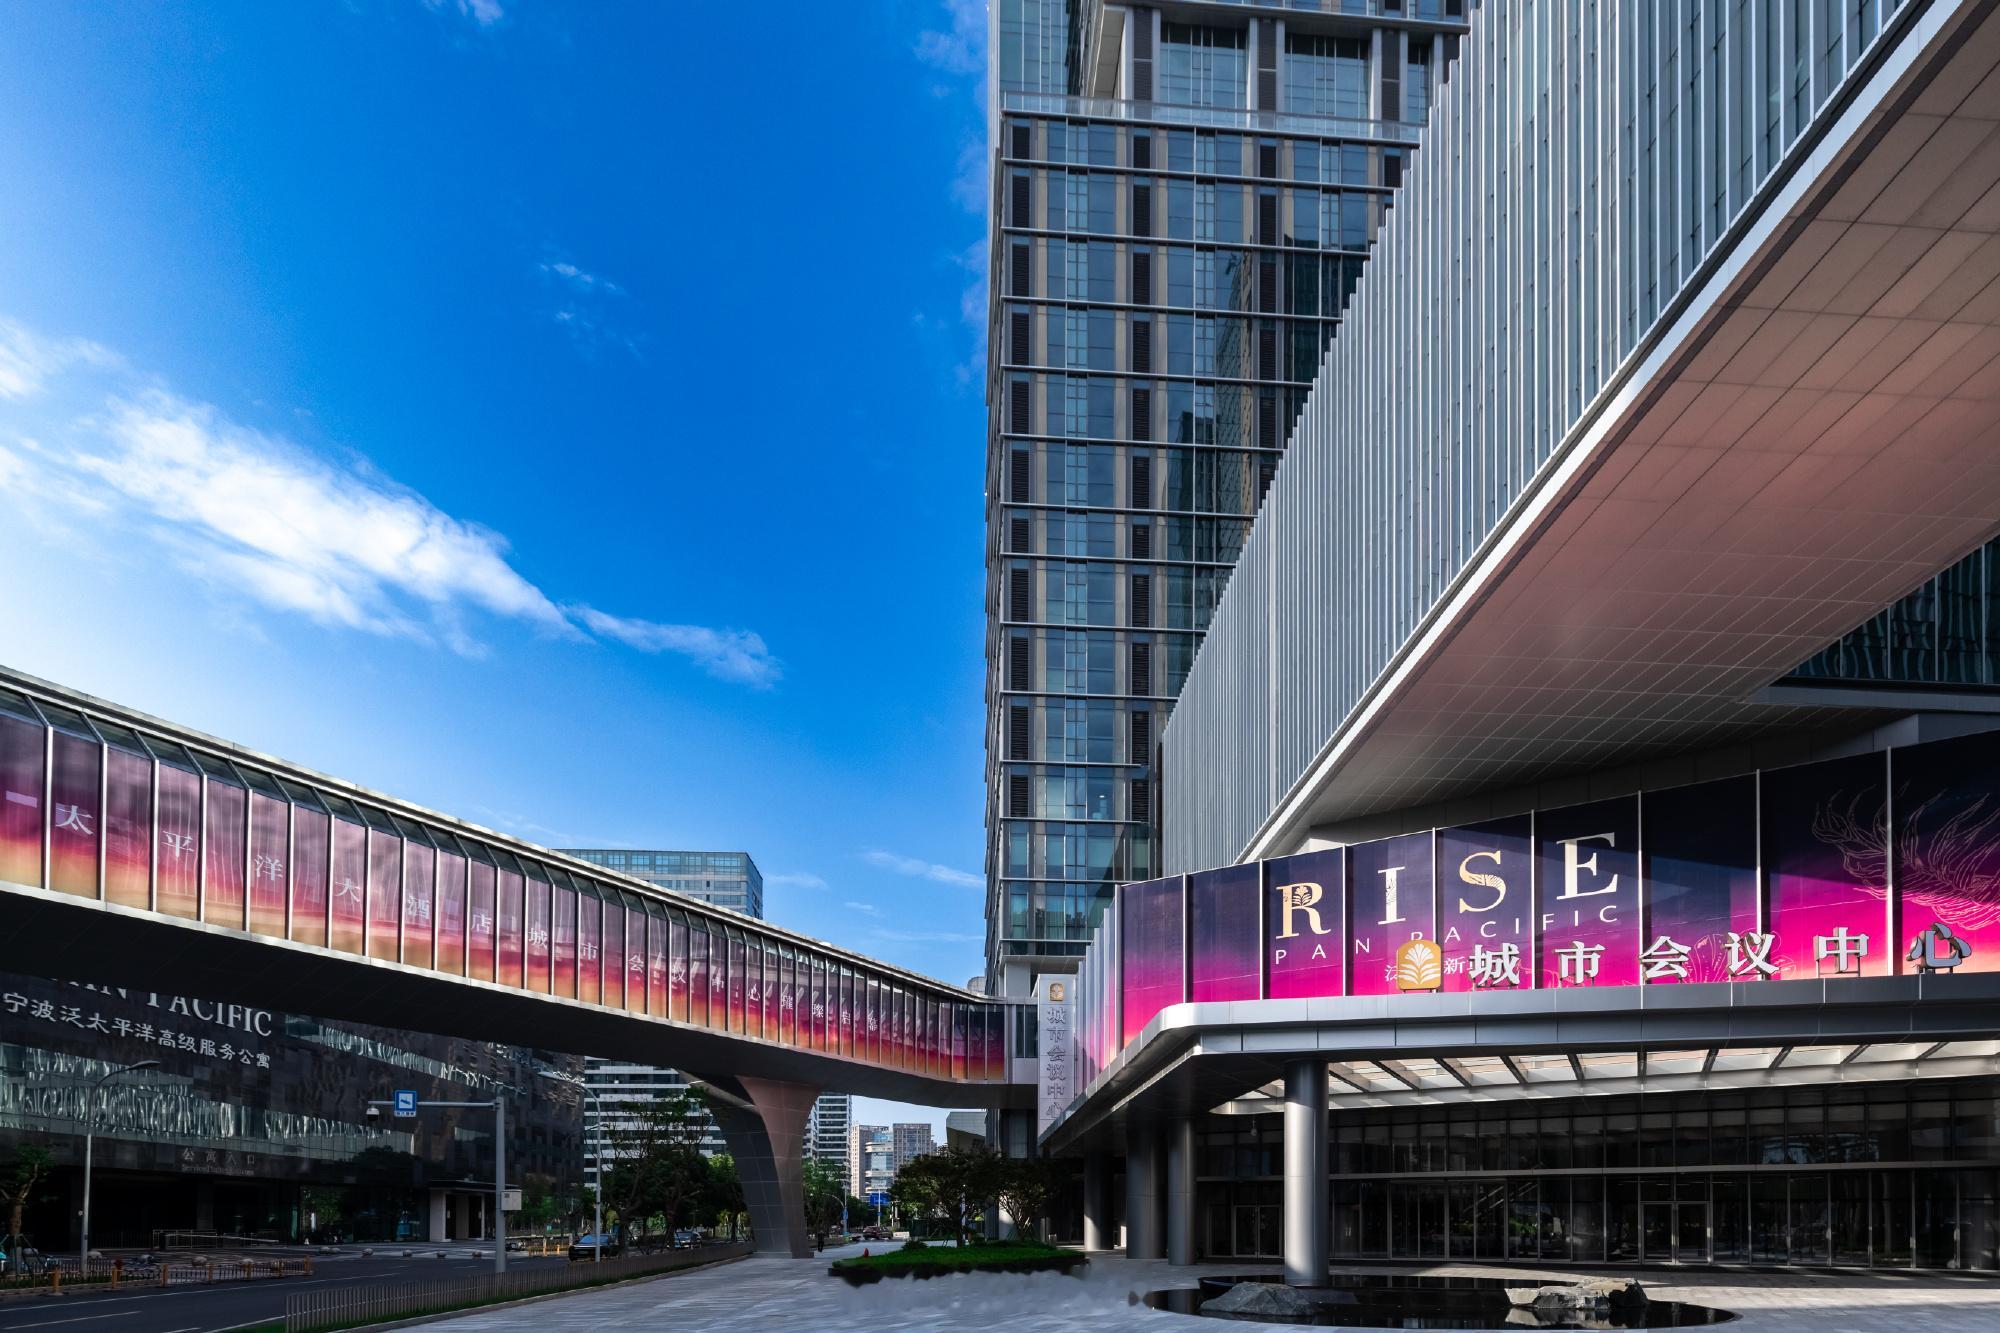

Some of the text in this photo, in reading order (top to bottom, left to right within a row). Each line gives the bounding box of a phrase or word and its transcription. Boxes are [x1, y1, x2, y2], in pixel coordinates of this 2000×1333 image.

[1275, 832, 1619, 939] RISE
[1275, 905, 1618, 965] PAN PACIFIC
[1468, 922, 1972, 986] 城市会议中心
[2, 992, 271, 1069] 宁波泛太平洋高级服务公寓
[1046, 1006, 1067, 1119] 城市会议中心
